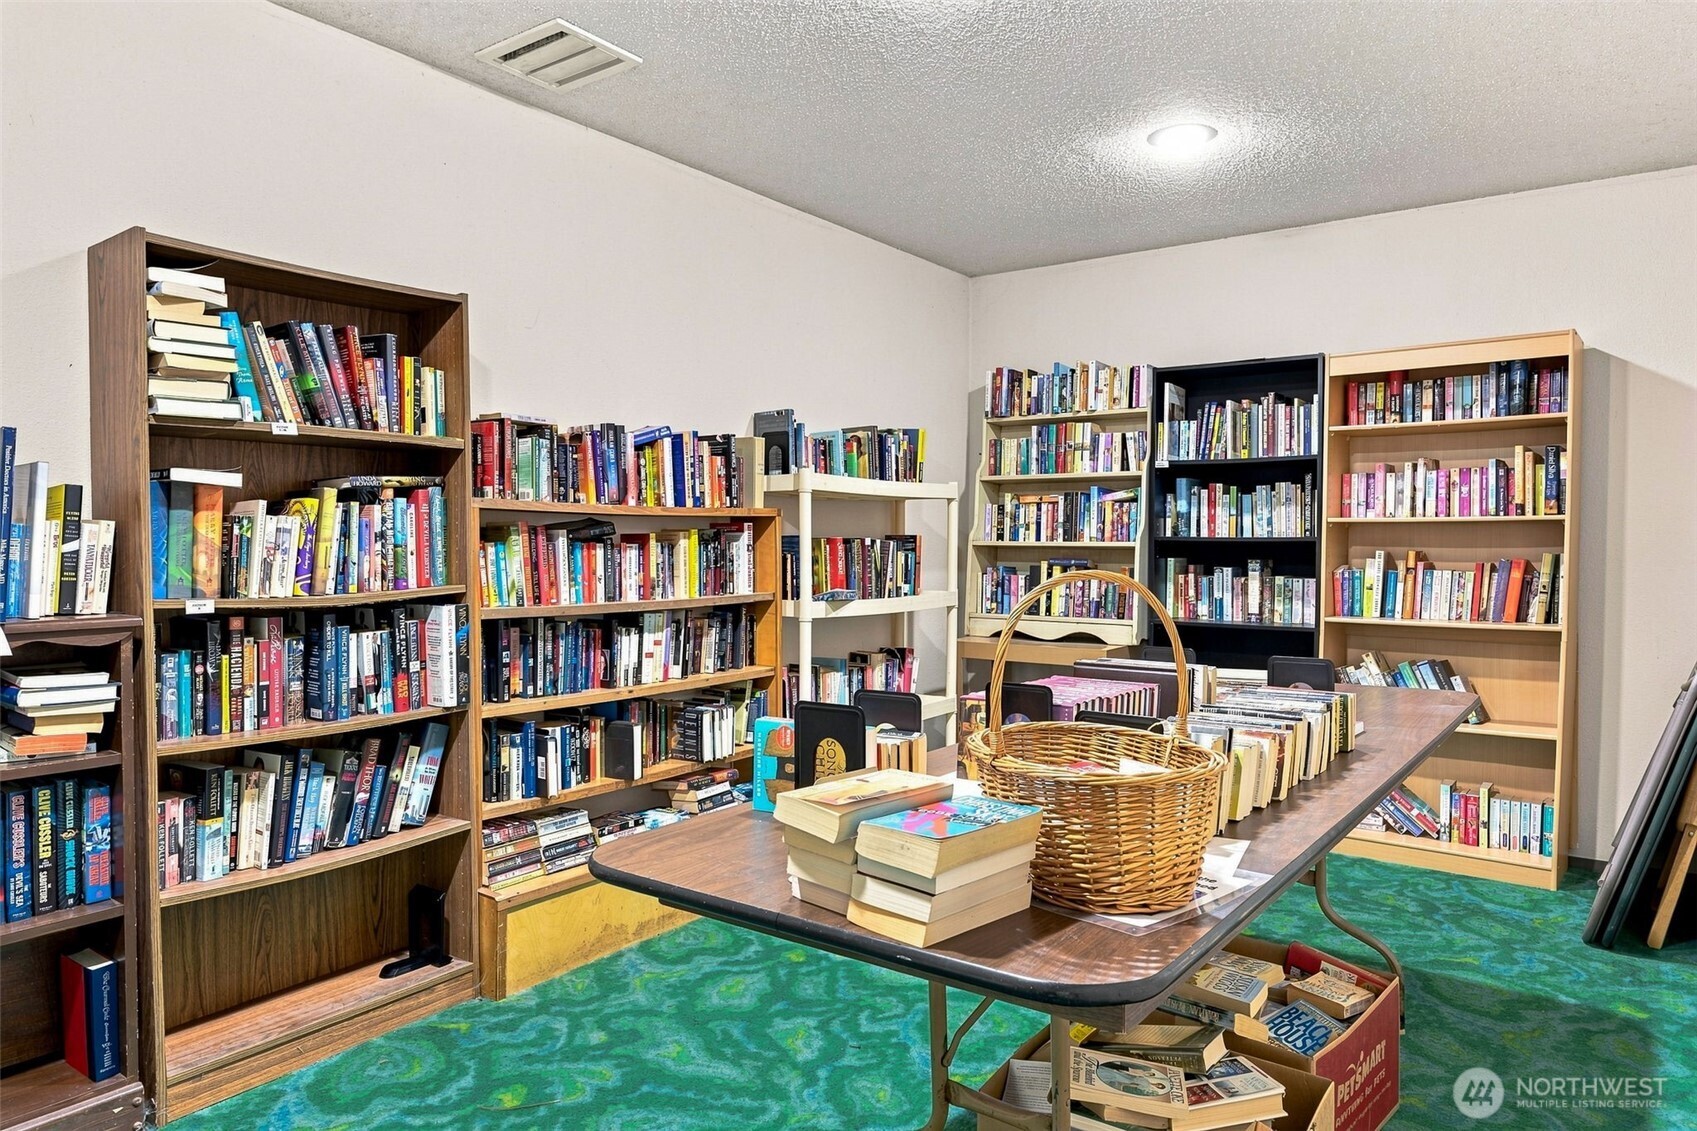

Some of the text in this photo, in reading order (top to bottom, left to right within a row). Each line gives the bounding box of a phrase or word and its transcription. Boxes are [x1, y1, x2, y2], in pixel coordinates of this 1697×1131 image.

[294, 326, 306, 349] KYLE
[326, 328, 346, 392] RISING PHOENIX
[353, 332, 365, 383] VINCE FLYNN
[3, 465, 11, 487] Doctors
[84, 561, 95, 582] TUCKER
[459, 607, 467, 630] VINCE
[230, 646, 242, 690] HACIENDA
[684, 713, 697, 760] DENNIS
[360, 739, 380, 792] BRAD THOR
[12, 795, 24, 821] CLIVE
[38, 789, 51, 859] CLIVE CUSSLER
[66, 840, 75, 870] SHOCK
[39, 871, 48, 903] SABOTEURS
[66, 871, 75, 895] WAVE
[1213, 973, 1238, 992] WIGGS
[1227, 976, 1257, 998] SUSAN
[1267, 1016, 1324, 1056] HOUSE
[1280, 1006, 1334, 1041] BEACH
[1336, 1039, 1387, 1108] PETSMART
[1373, 1068, 1386, 1088] PETS
